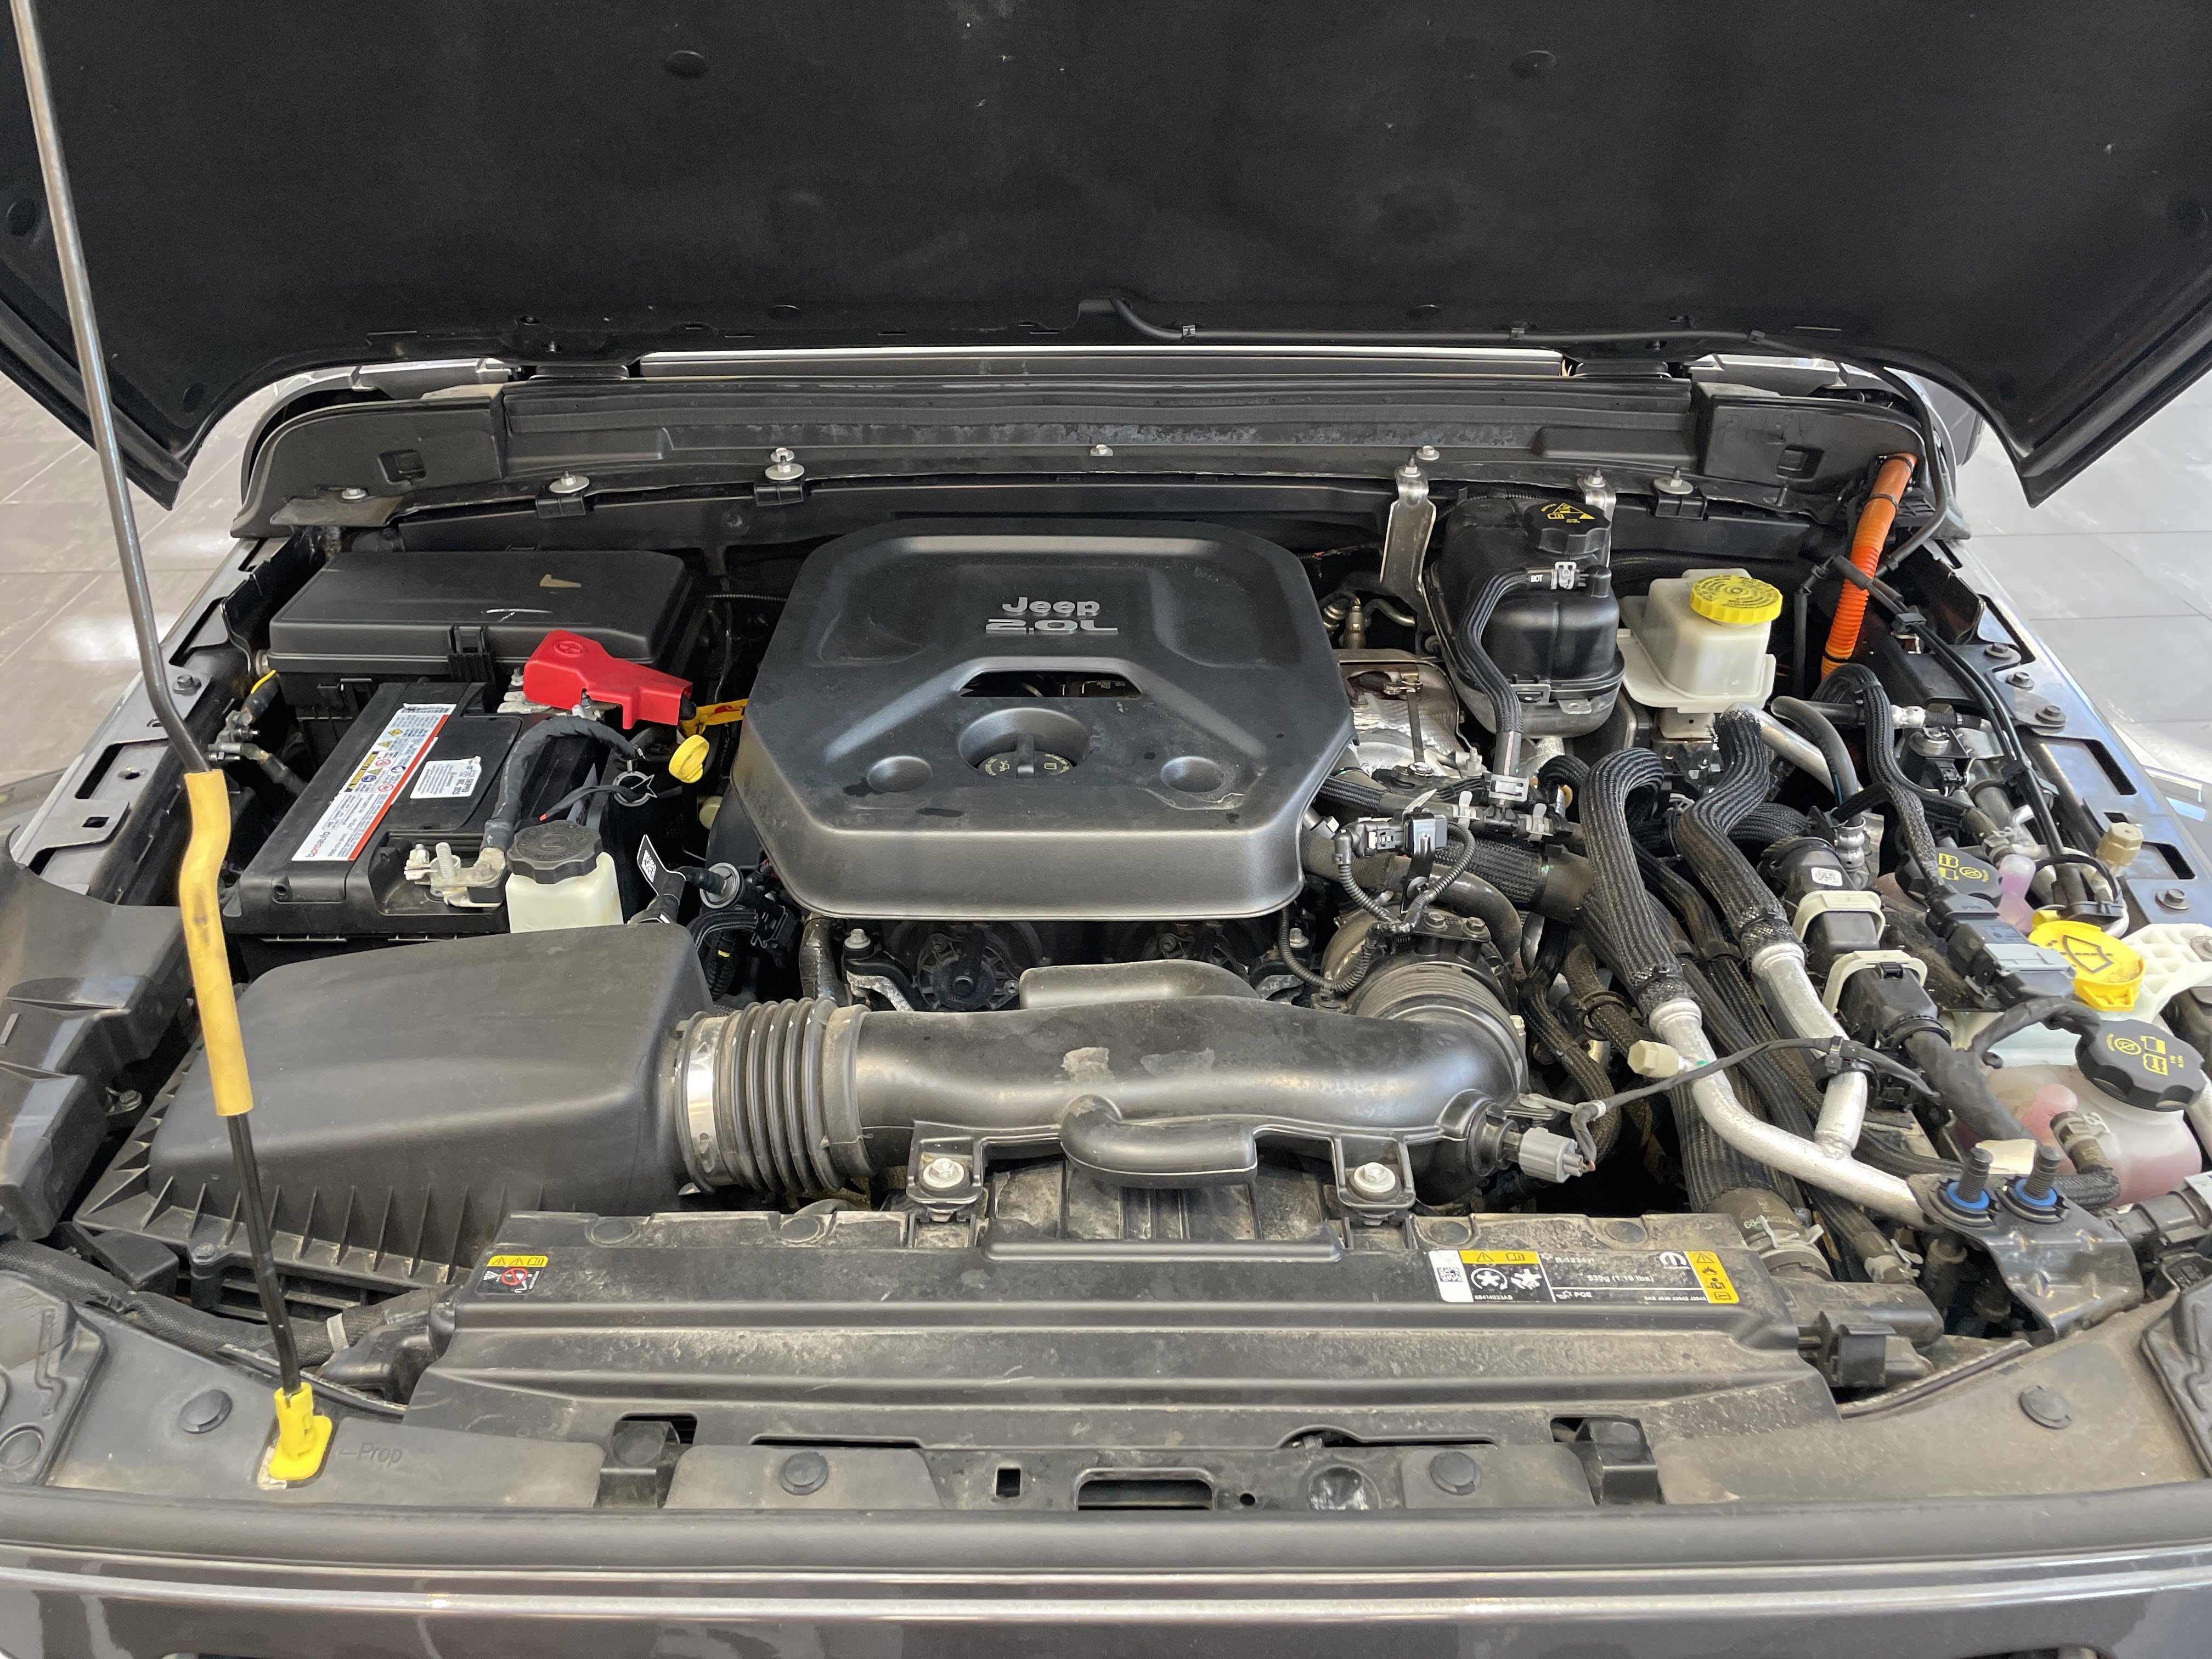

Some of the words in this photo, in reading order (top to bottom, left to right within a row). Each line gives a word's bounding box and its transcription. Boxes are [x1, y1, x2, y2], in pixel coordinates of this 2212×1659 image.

[1002, 596, 1100, 617] Jeep
[985, 618, 1118, 635] 2.0L
[358, 1441, 403, 1468] Prop
